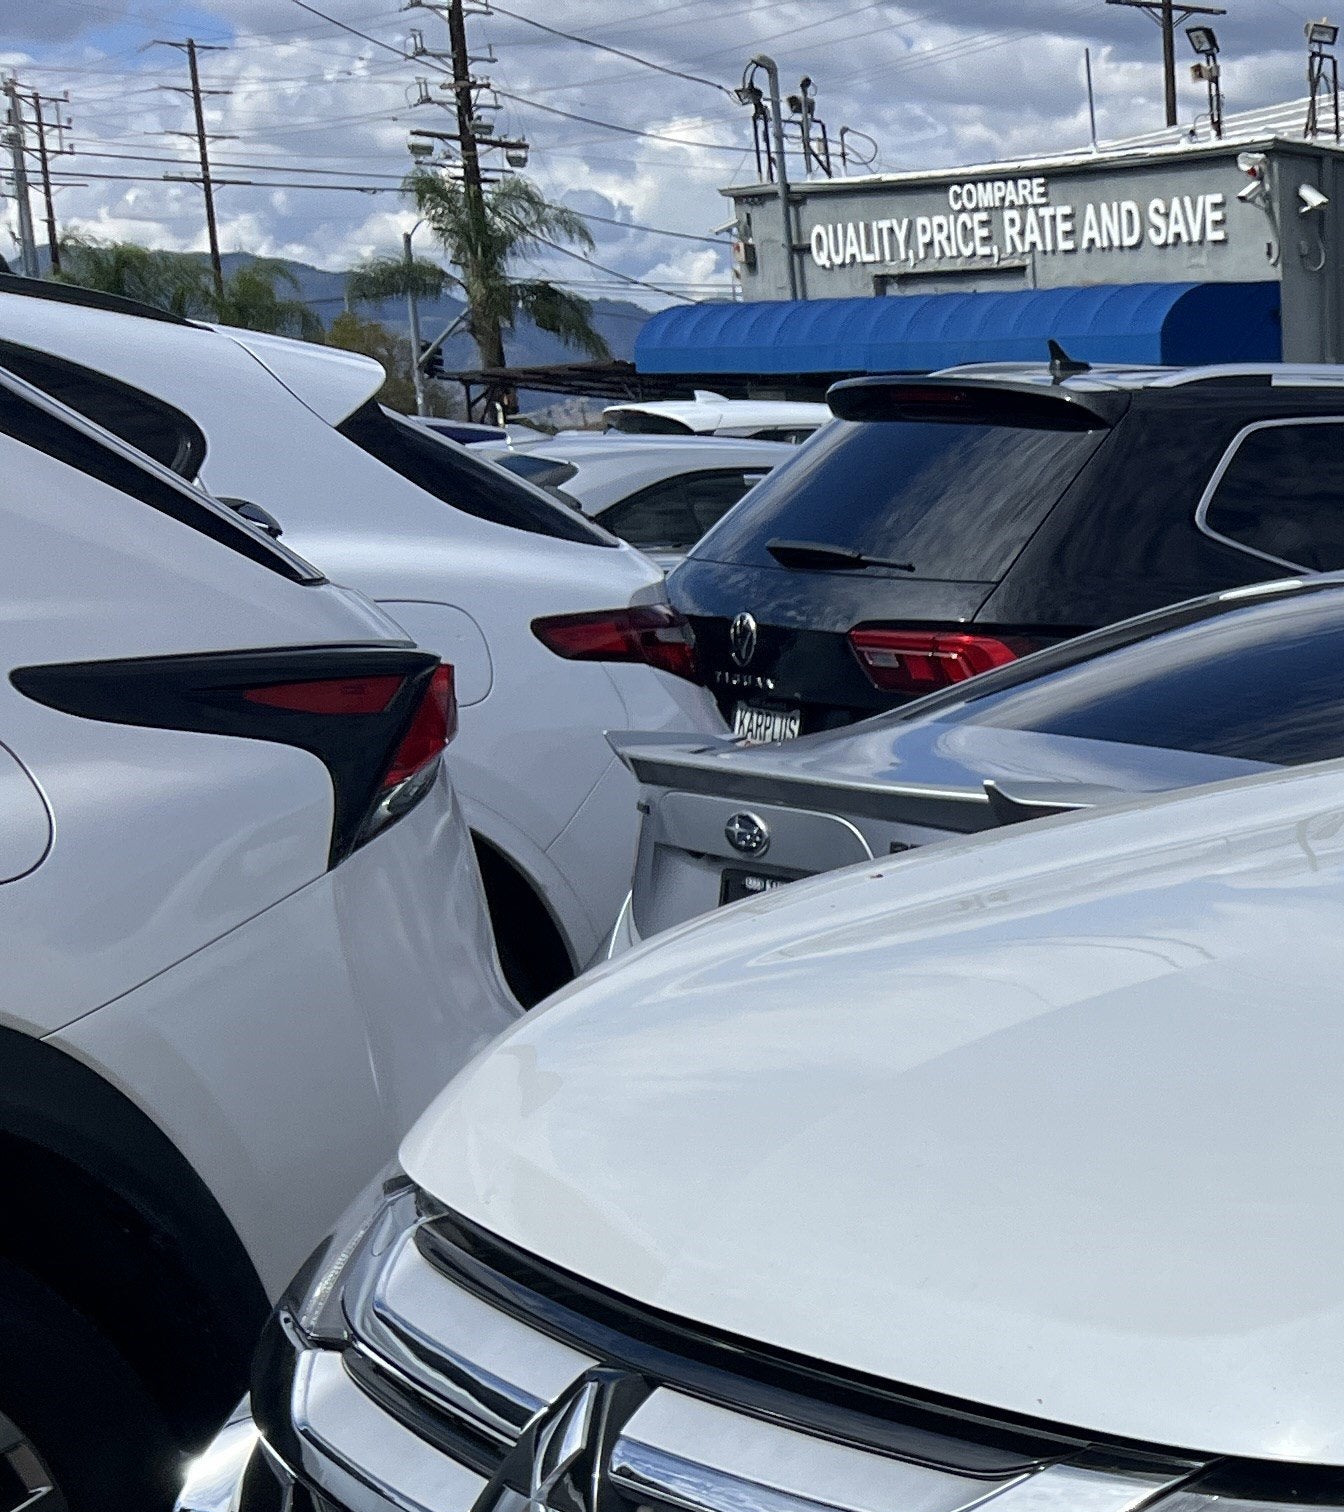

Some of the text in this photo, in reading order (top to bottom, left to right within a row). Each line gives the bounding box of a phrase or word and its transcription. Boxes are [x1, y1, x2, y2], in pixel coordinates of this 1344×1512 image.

[949, 177, 1047, 211] COMPARE
[810, 193, 1225, 268] QUALITY, PRICE, RATE AND SAVE
[738, 709, 798, 742] KARPLUS
